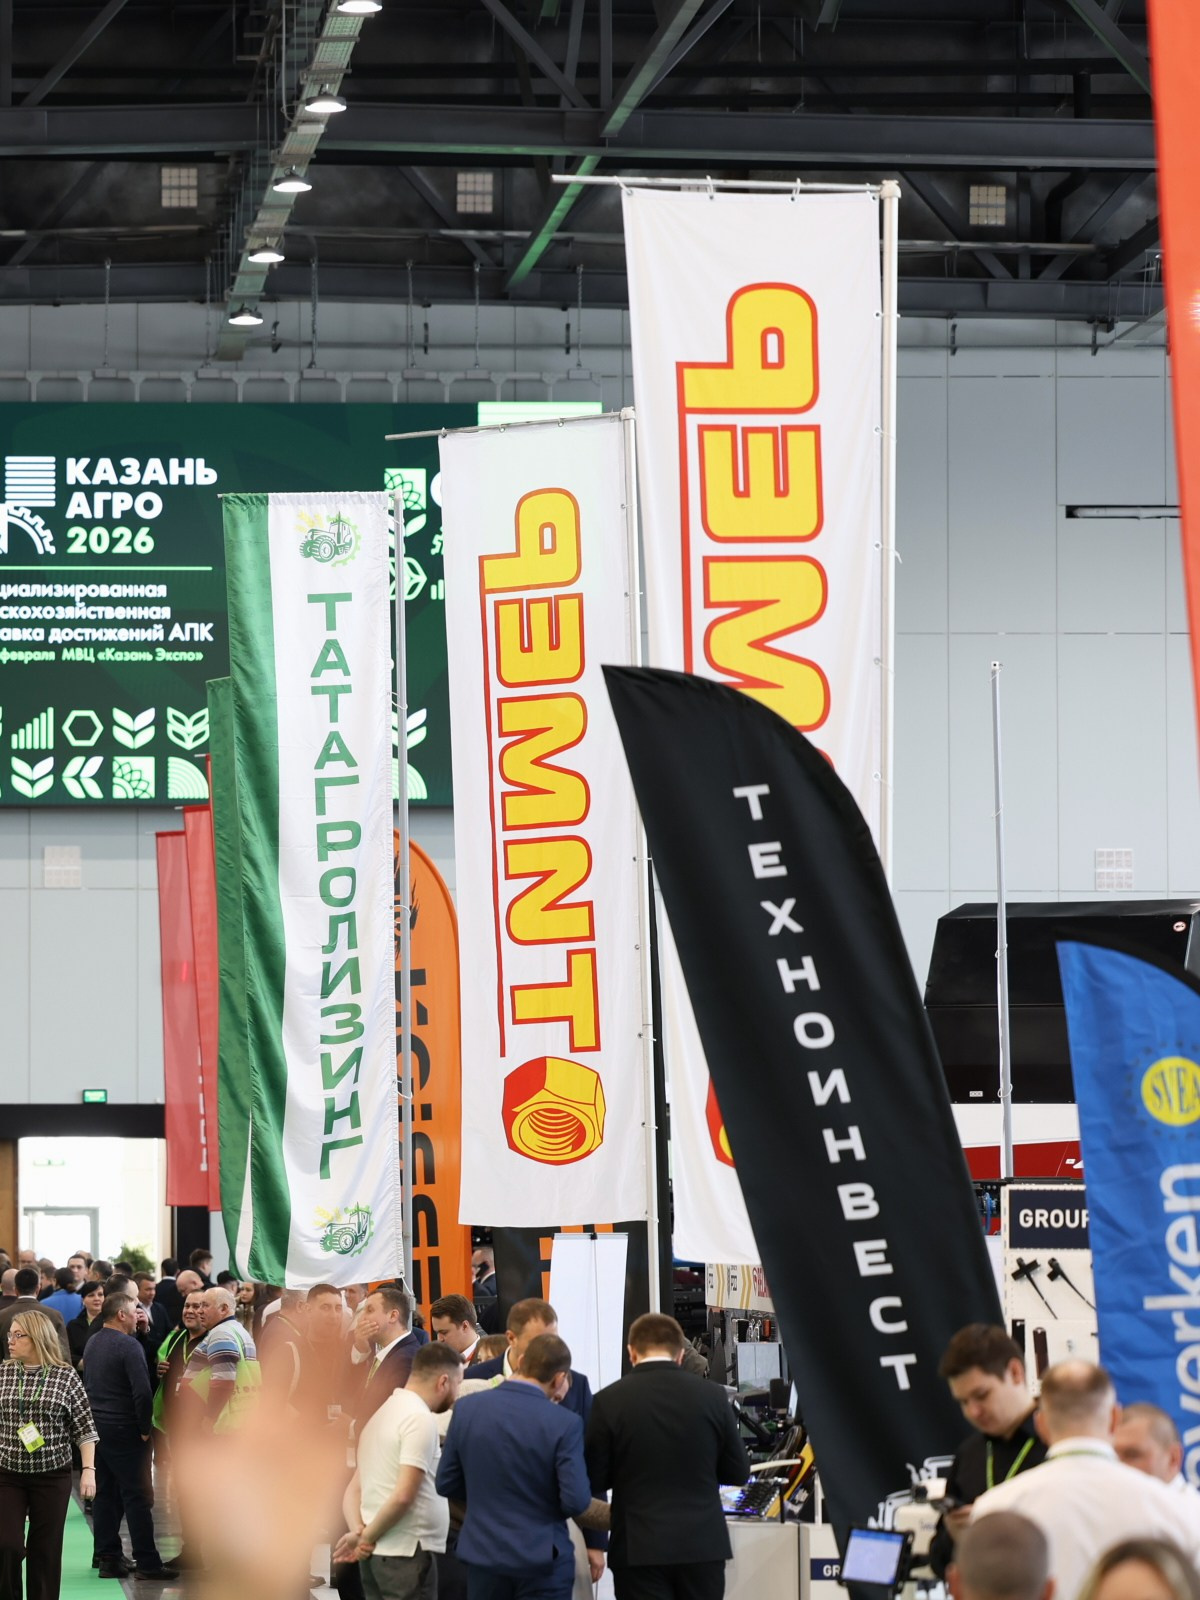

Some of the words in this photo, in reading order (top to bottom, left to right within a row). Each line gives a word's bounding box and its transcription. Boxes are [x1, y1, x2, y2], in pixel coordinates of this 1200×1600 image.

[65, 456, 218, 486] КАЗАНЬ
[65, 491, 163, 520] АГРО
[66, 526, 155, 554] 2026
[48, 623, 164, 644] достижений
[168, 623, 215, 642] АПК
[62, 648, 95, 663] МВЦ
[97, 648, 153, 661] «Казань
[155, 648, 204, 662] Экспо»
[307, 592, 366, 1181] ТАТАГРОЛИЗИНГ
[732, 784, 917, 1391] ТЕХНОИНВЕСТ
